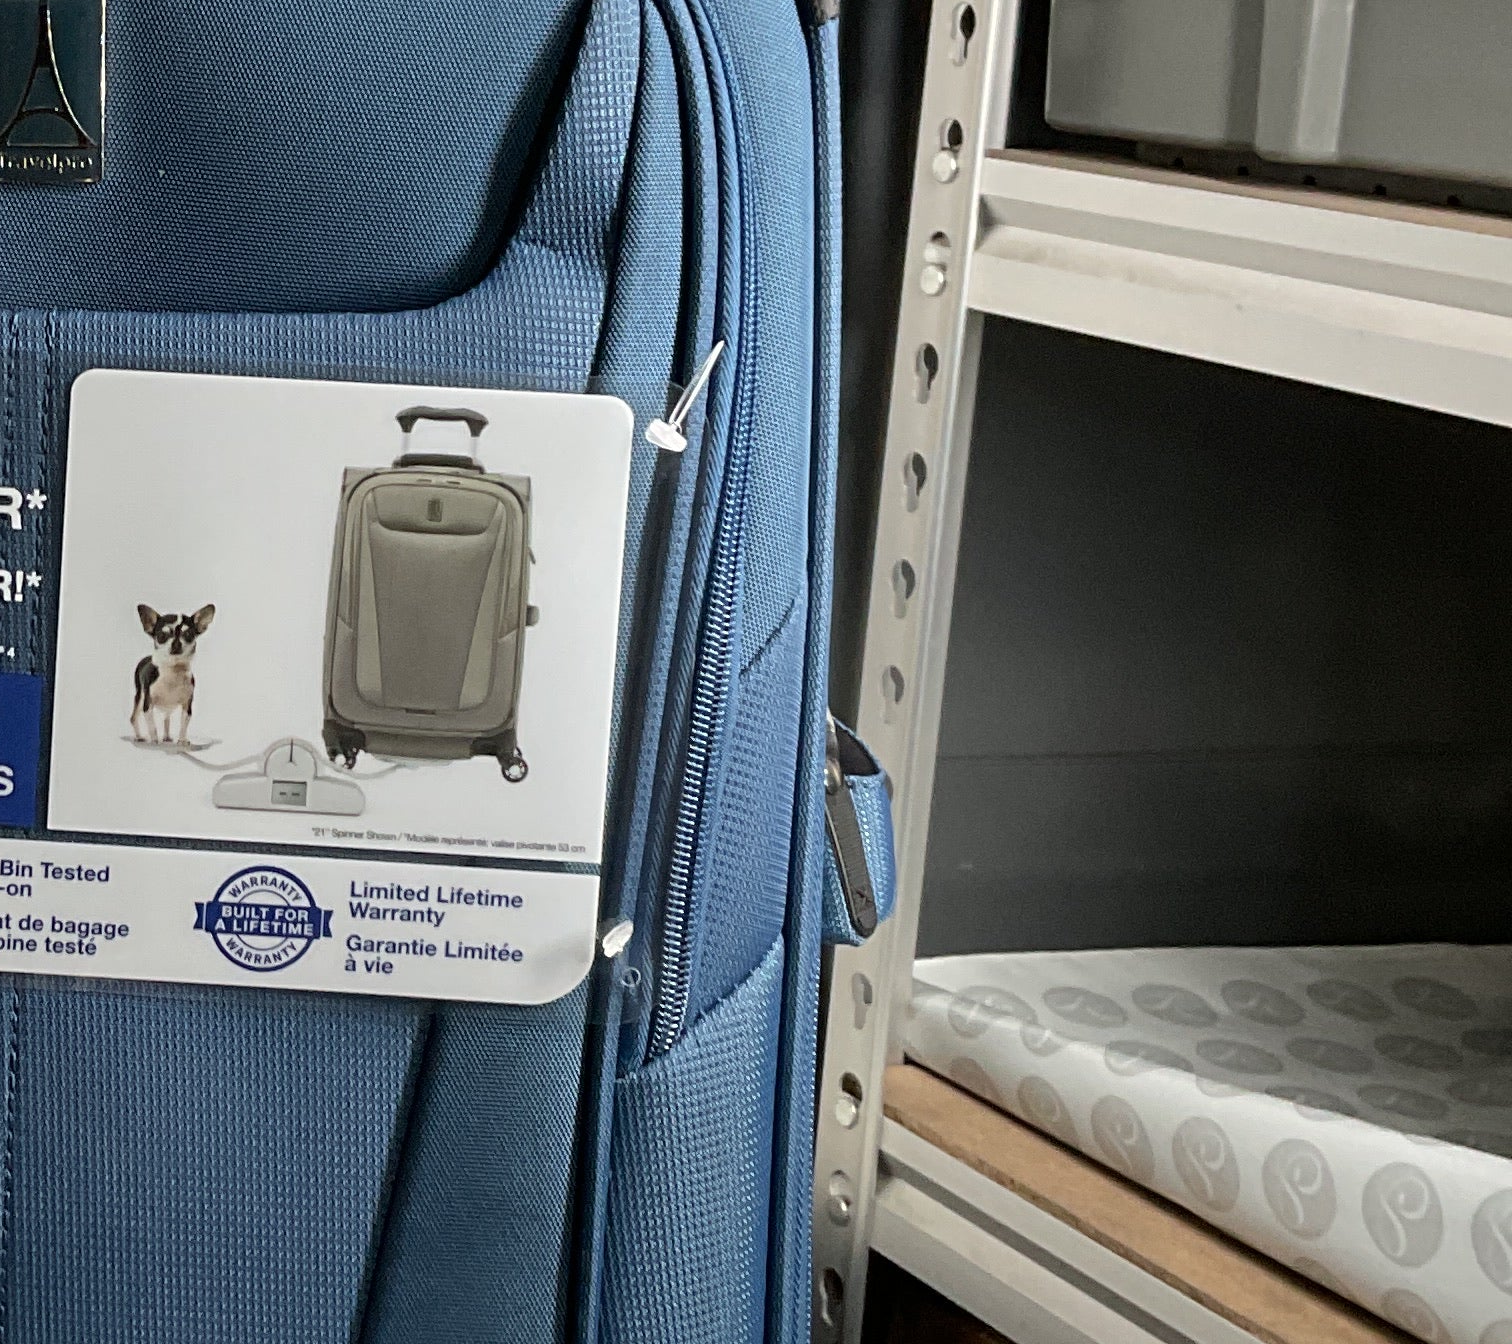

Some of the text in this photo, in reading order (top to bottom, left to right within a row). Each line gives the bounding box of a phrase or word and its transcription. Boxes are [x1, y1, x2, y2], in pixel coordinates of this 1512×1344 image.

[7, 647, 16, 659] 4
[0, 859, 33, 879] Bin
[40, 862, 111, 884] Tested
[228, 875, 303, 903] WARRANTY
[349, 880, 524, 908] Limited Lifetime
[221, 904, 309, 922] BUILT FOR
[348, 901, 446, 927] Warranty
[17, 913, 44, 933] de
[51, 917, 131, 941] bagage
[214, 917, 315, 937] A LIFETIME
[44, 934, 98, 956] testé
[225, 936, 299, 966] WARRANTY
[345, 934, 525, 962] Garantie Limitée
[344, 955, 394, 975] à vie
